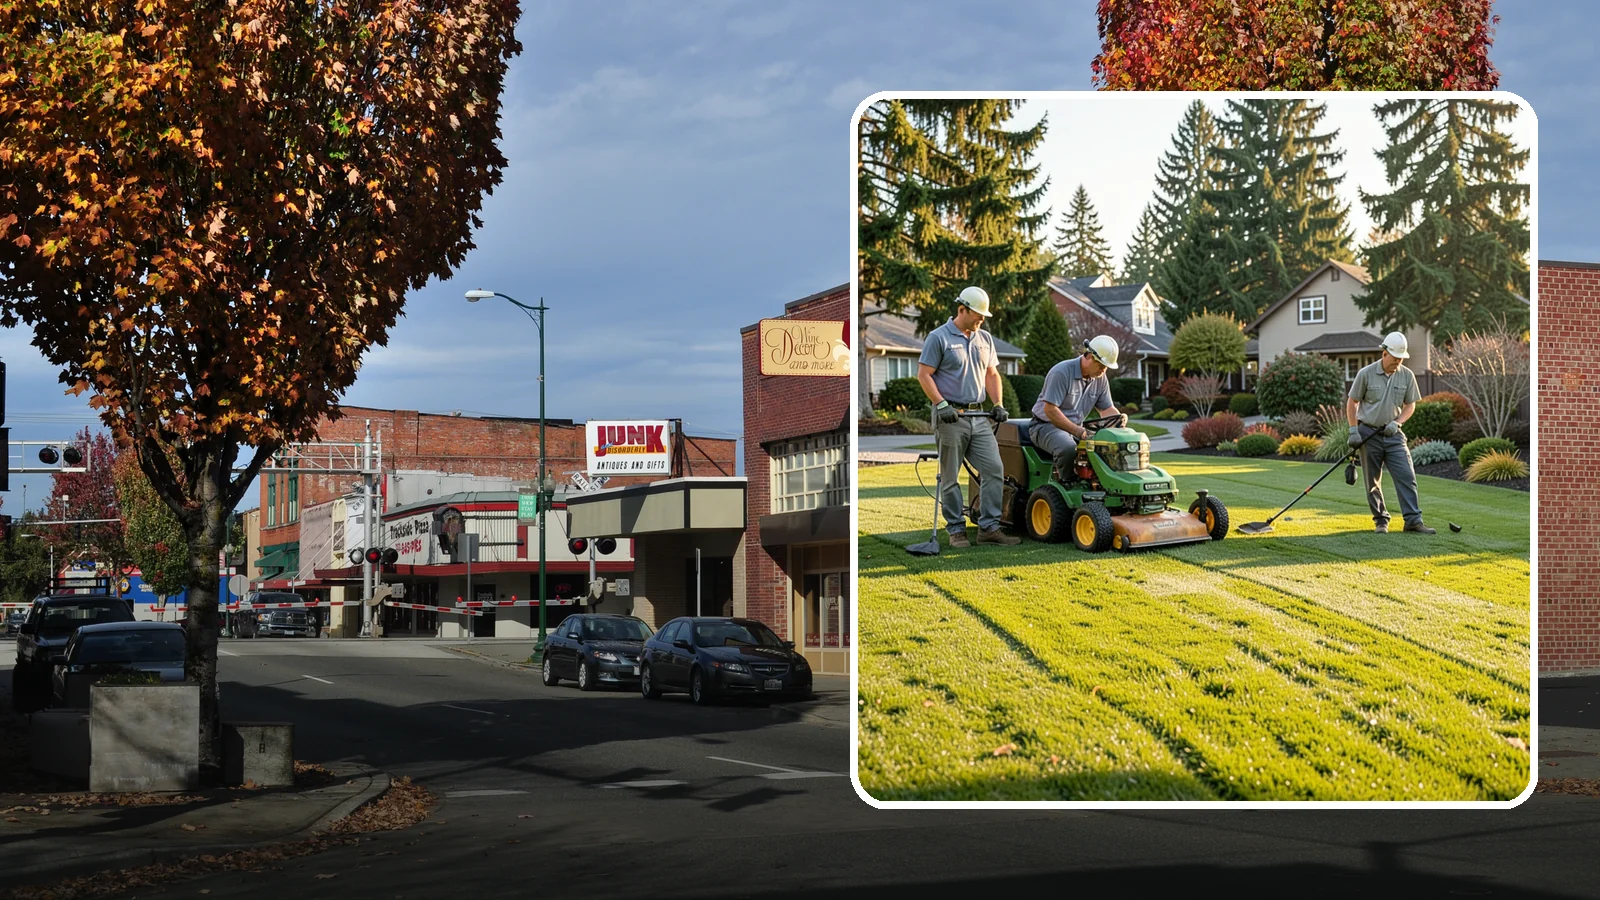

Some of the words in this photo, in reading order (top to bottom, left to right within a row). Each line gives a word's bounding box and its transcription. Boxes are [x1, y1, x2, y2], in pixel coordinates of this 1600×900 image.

[595, 425, 665, 457] JUNK
[607, 446, 645, 454] DISORDERLY
[597, 461, 628, 470] ANTIQUES
[631, 461, 644, 470] AND
[647, 461, 665, 470] GIFTS
[390, 521, 413, 540] Trackside
[414, 519, 429, 535] Pizza
